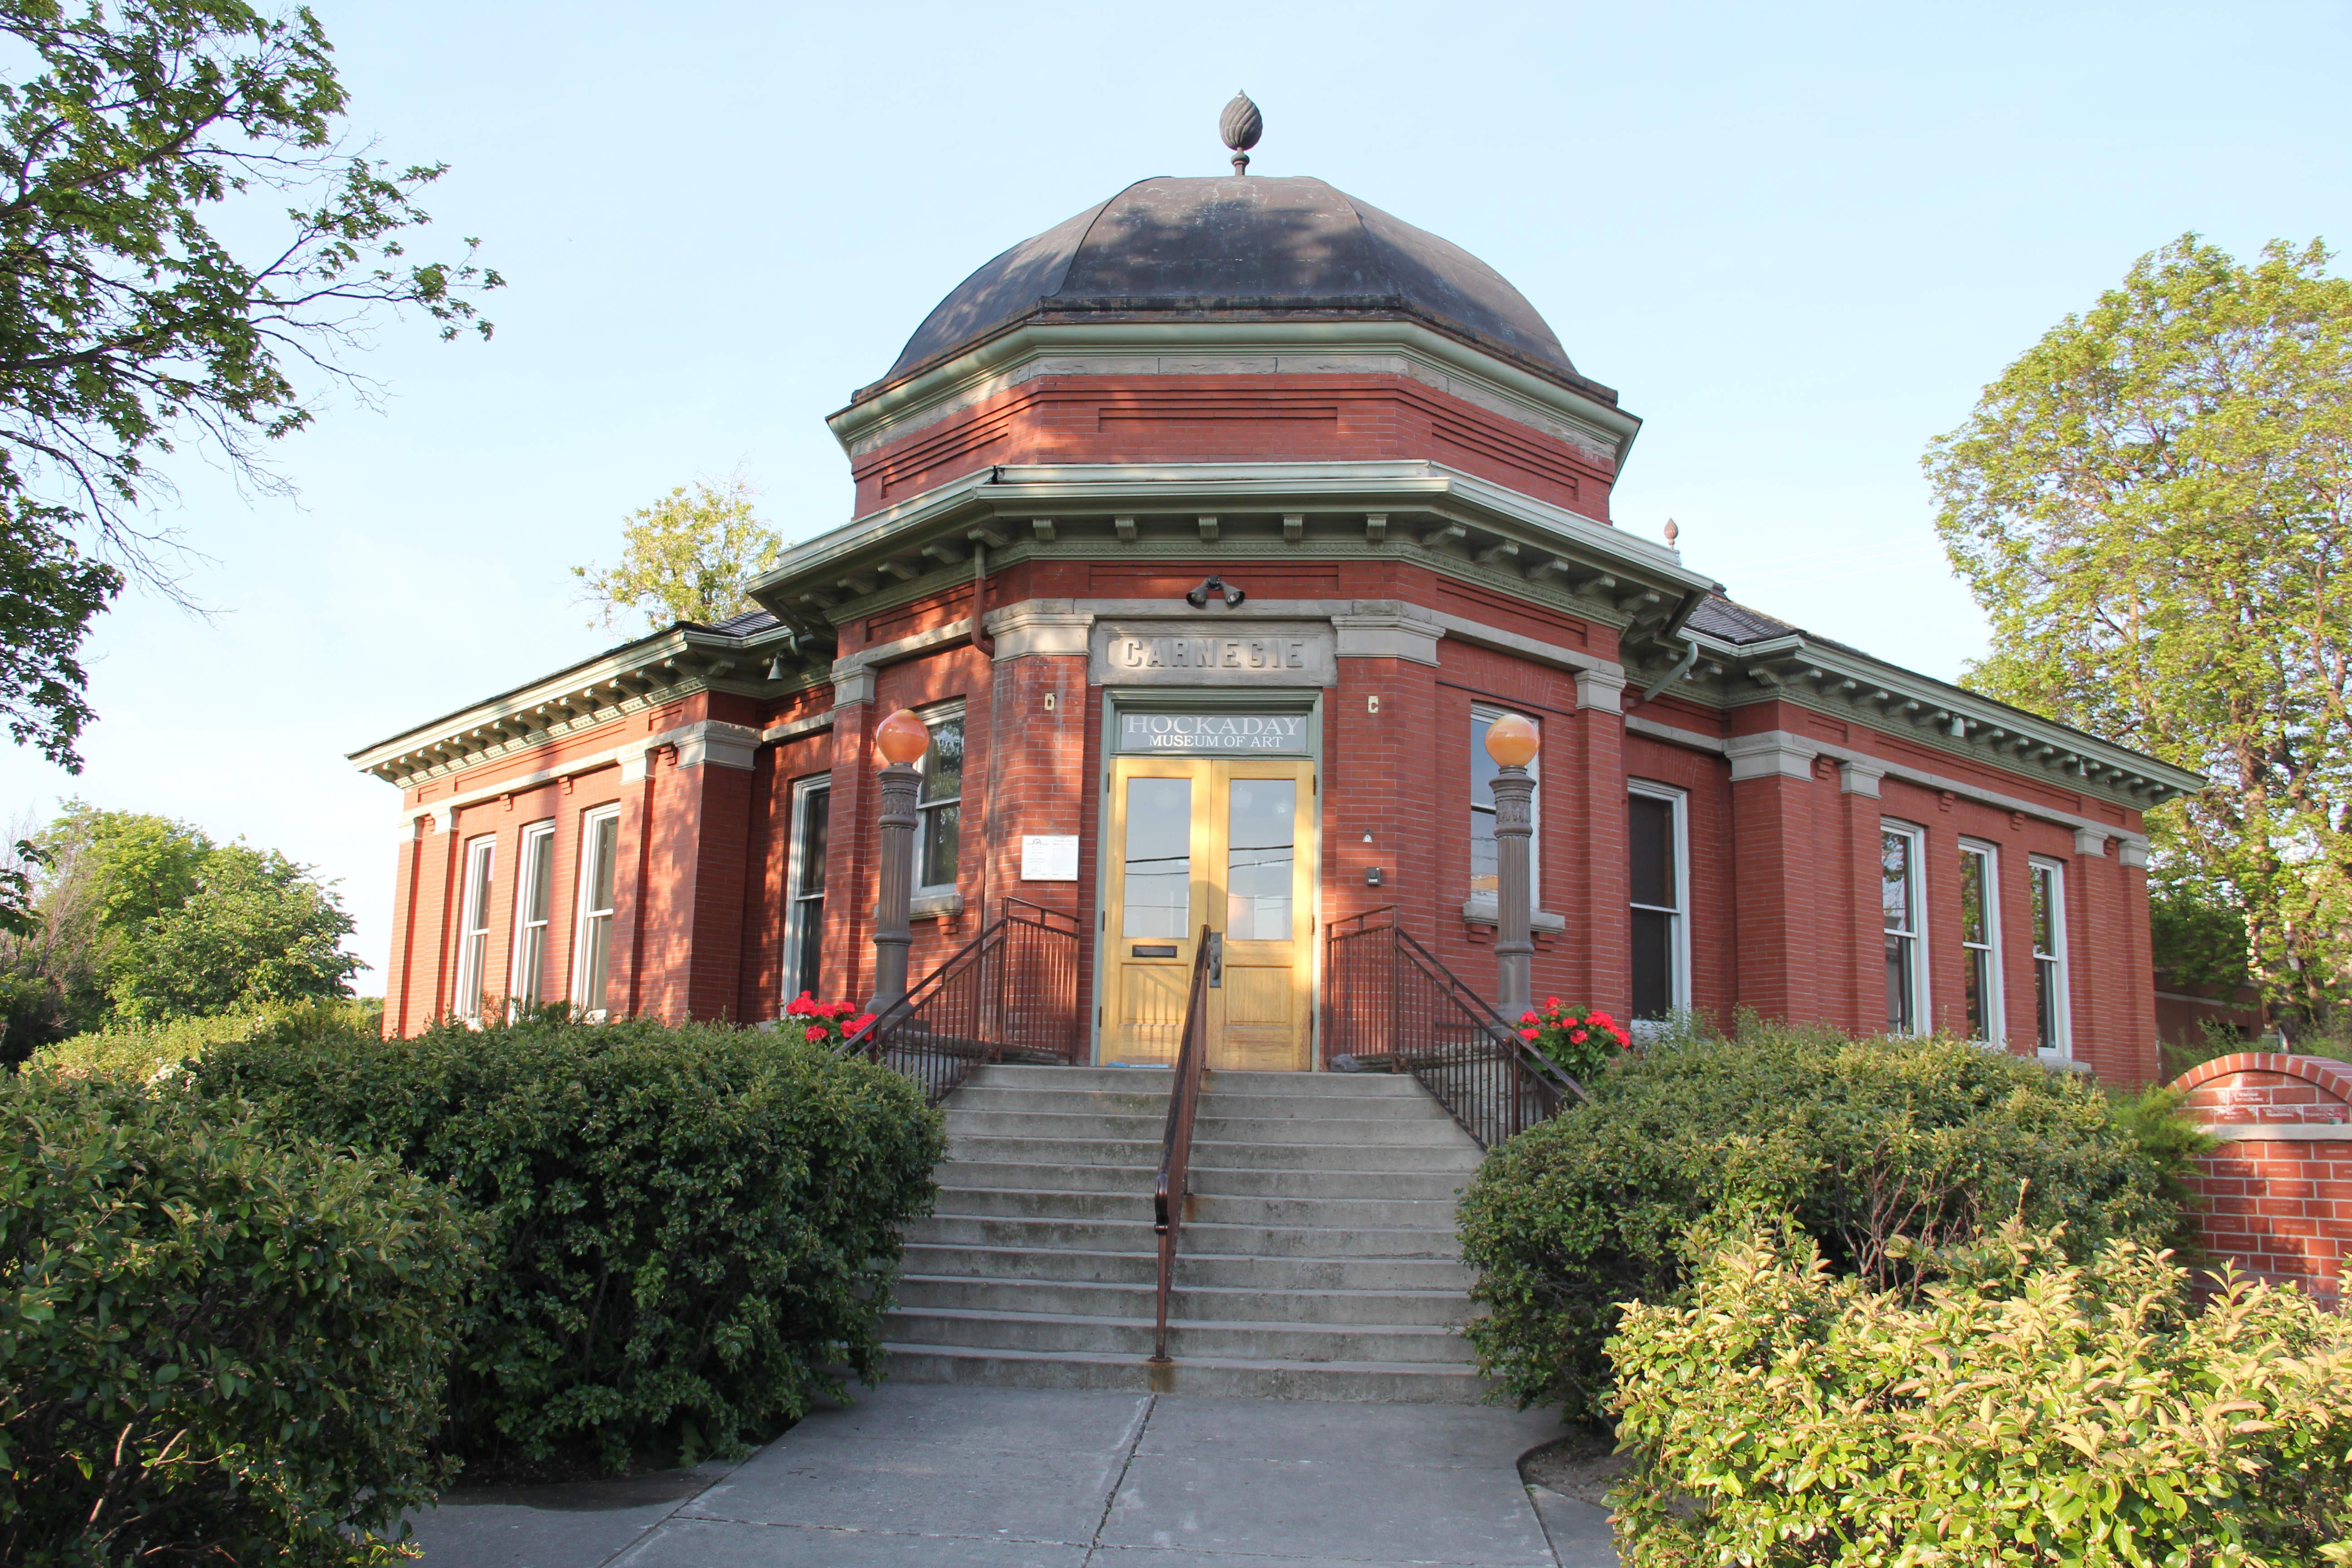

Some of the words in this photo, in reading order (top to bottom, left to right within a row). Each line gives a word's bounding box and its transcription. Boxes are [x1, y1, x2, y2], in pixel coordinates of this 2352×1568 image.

[1122, 638, 1304, 667] CARNEGIE
[1127, 715, 1302, 735] HOCKADAY
[1149, 735, 1219, 747] MUSEUM
[1224, 735, 1246, 747] OF
[1250, 736, 1284, 748] ART
